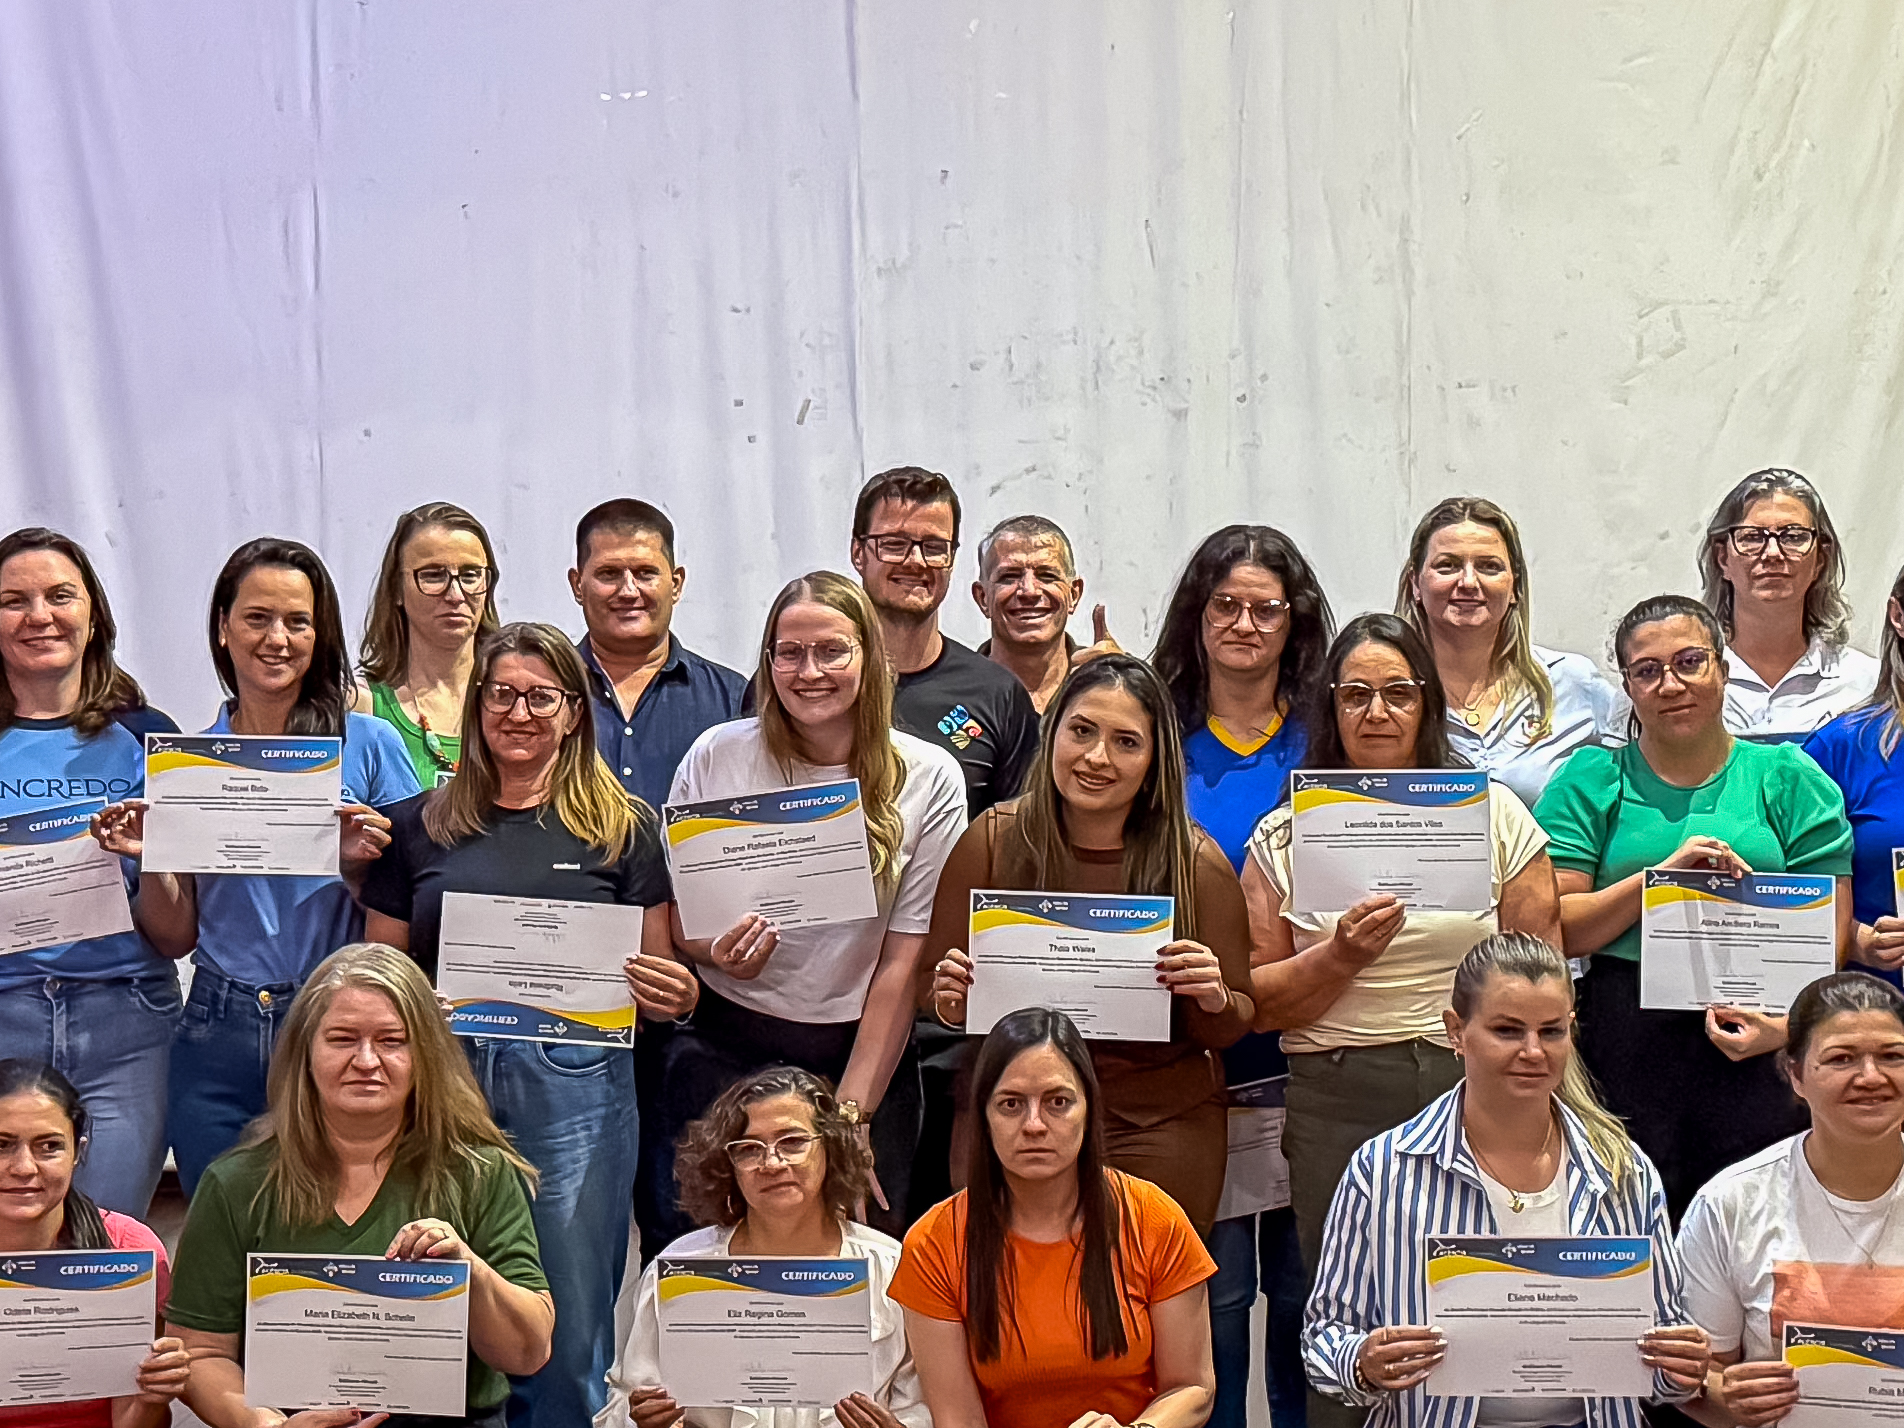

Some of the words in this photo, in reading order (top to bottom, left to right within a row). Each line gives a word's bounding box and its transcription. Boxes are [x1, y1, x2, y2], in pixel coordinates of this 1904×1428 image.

[1407, 783, 1476, 793] CERTIFICADO
[1755, 885, 1821, 897] CERTIFICADO
[378, 1272, 454, 1285] CERTIFICADO
